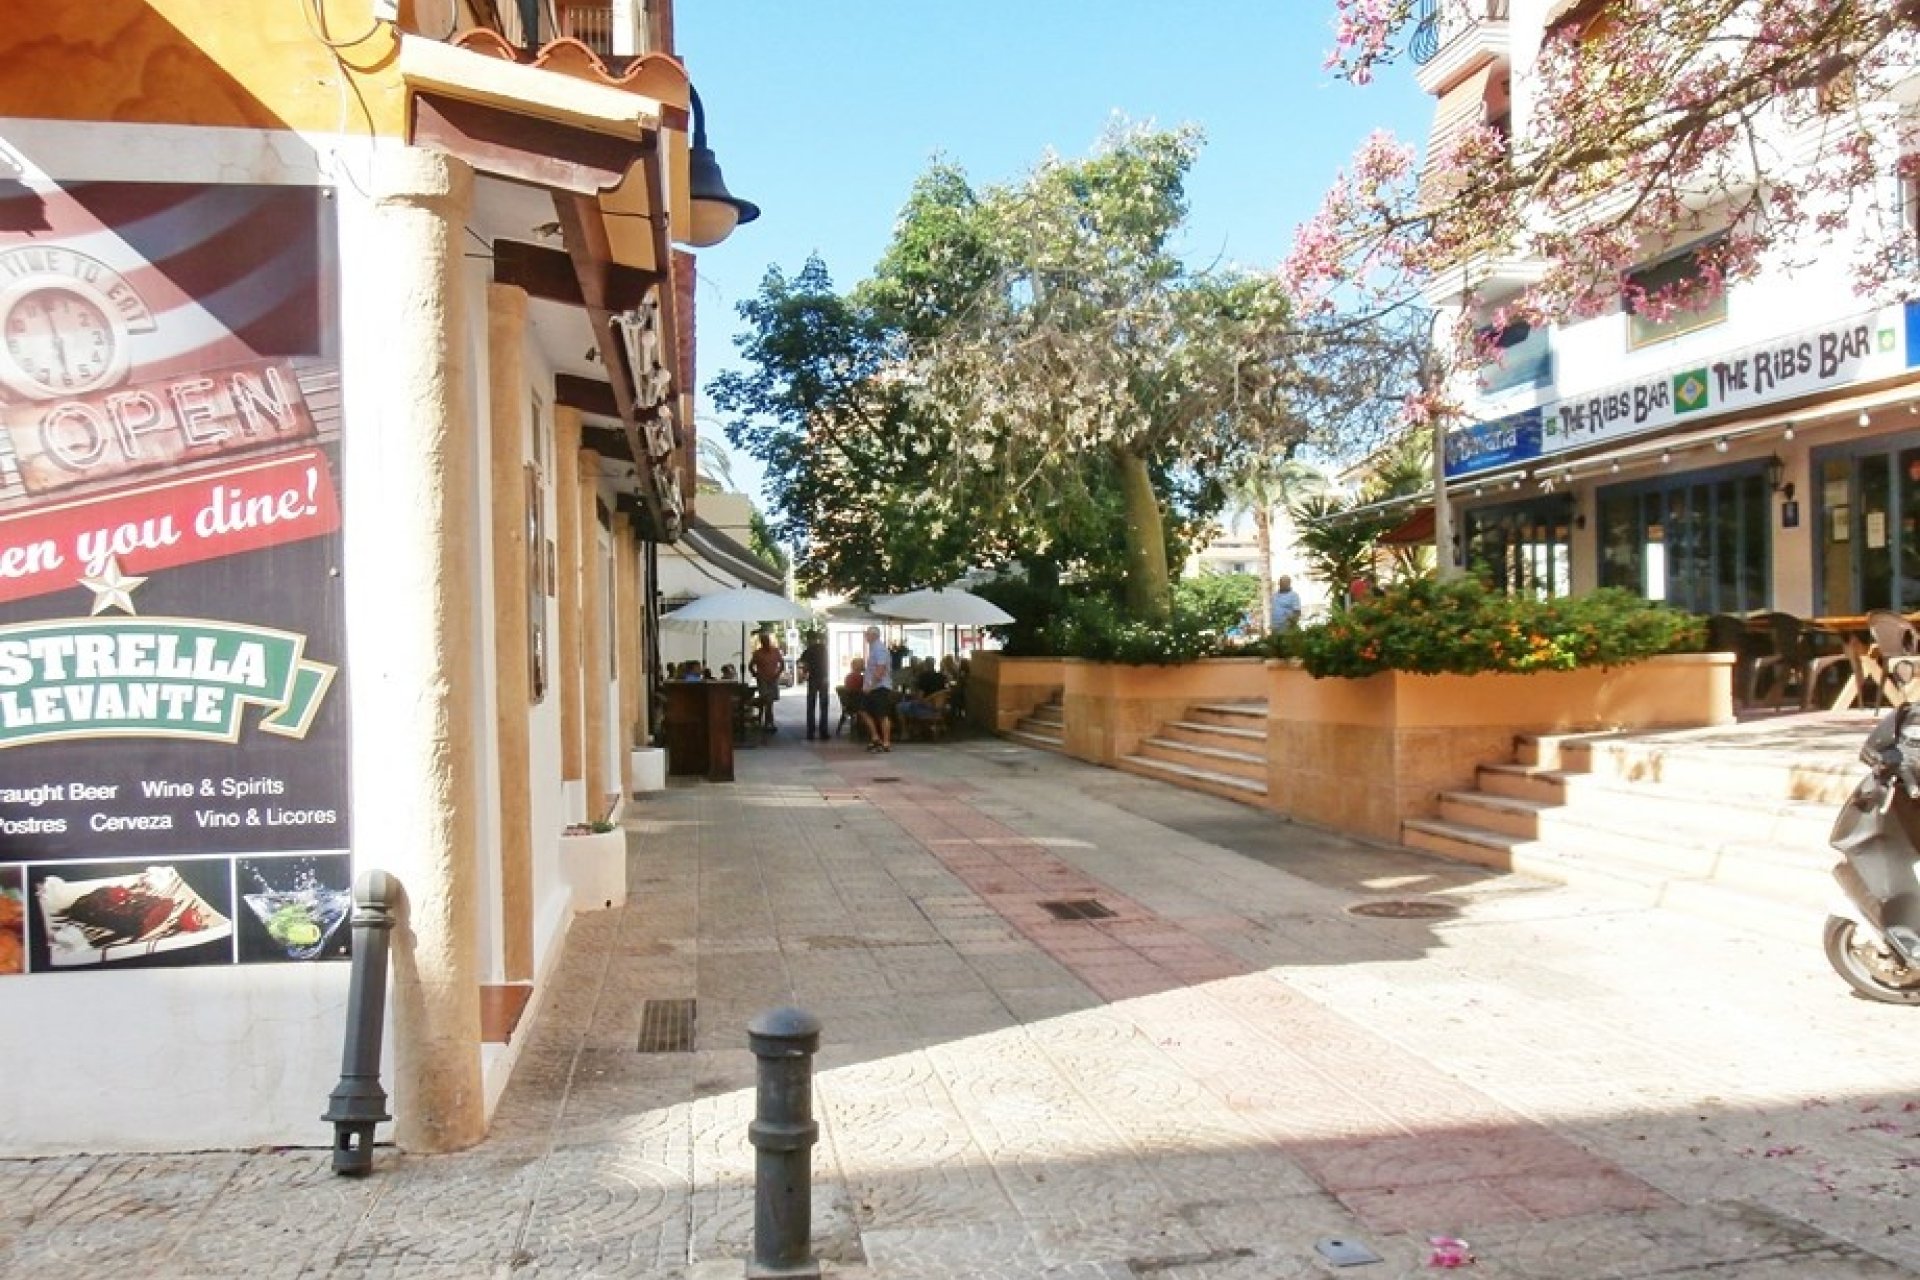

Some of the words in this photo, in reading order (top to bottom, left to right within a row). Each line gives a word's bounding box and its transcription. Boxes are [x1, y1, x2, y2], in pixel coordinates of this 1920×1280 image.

[1713, 359, 1748, 402] THE
[1818, 325, 1871, 379] BAR
[40, 367, 297, 471] OPEN
[1558, 404, 1585, 438] THE
[1634, 380, 1670, 423] BAR
[0, 537, 63, 579] en
[76, 514, 181, 577] you
[194, 468, 319, 538] dine!
[0, 684, 226, 728] LEVANTE
[69, 782, 118, 800] Beer
[141, 779, 194, 798] Wine
[199, 778, 216, 797] &
[221, 776, 285, 799] Spirits
[90, 812, 173, 832] Cerveza
[195, 809, 241, 828] Vino
[245, 807, 261, 826] &
[266, 806, 337, 825] Licores
